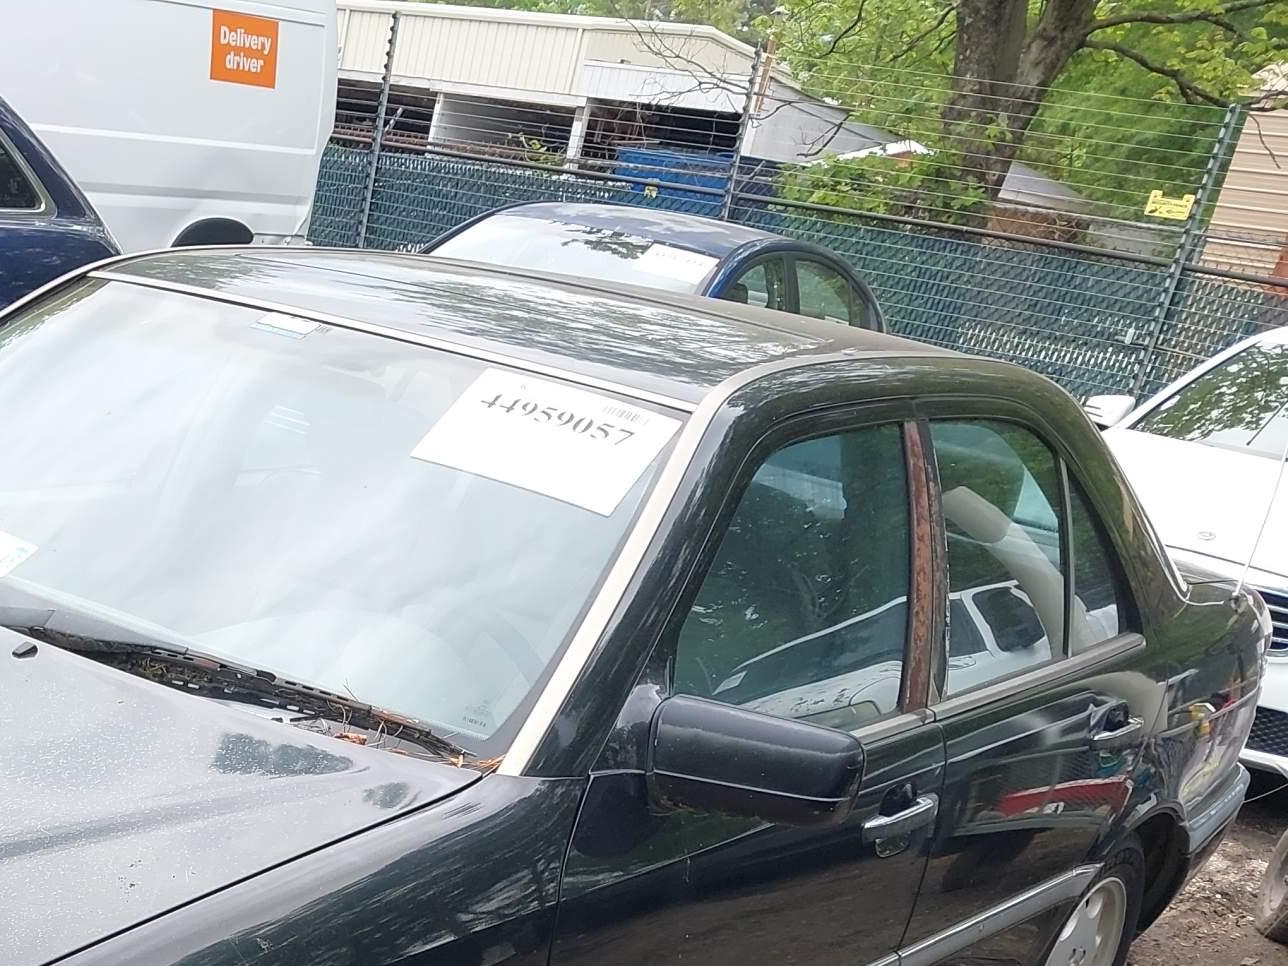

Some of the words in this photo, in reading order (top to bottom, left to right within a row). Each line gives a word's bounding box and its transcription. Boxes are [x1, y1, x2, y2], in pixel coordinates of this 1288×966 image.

[220, 25, 272, 55] Delivery
[225, 51, 264, 73] driver
[481, 393, 636, 445] 44959057
